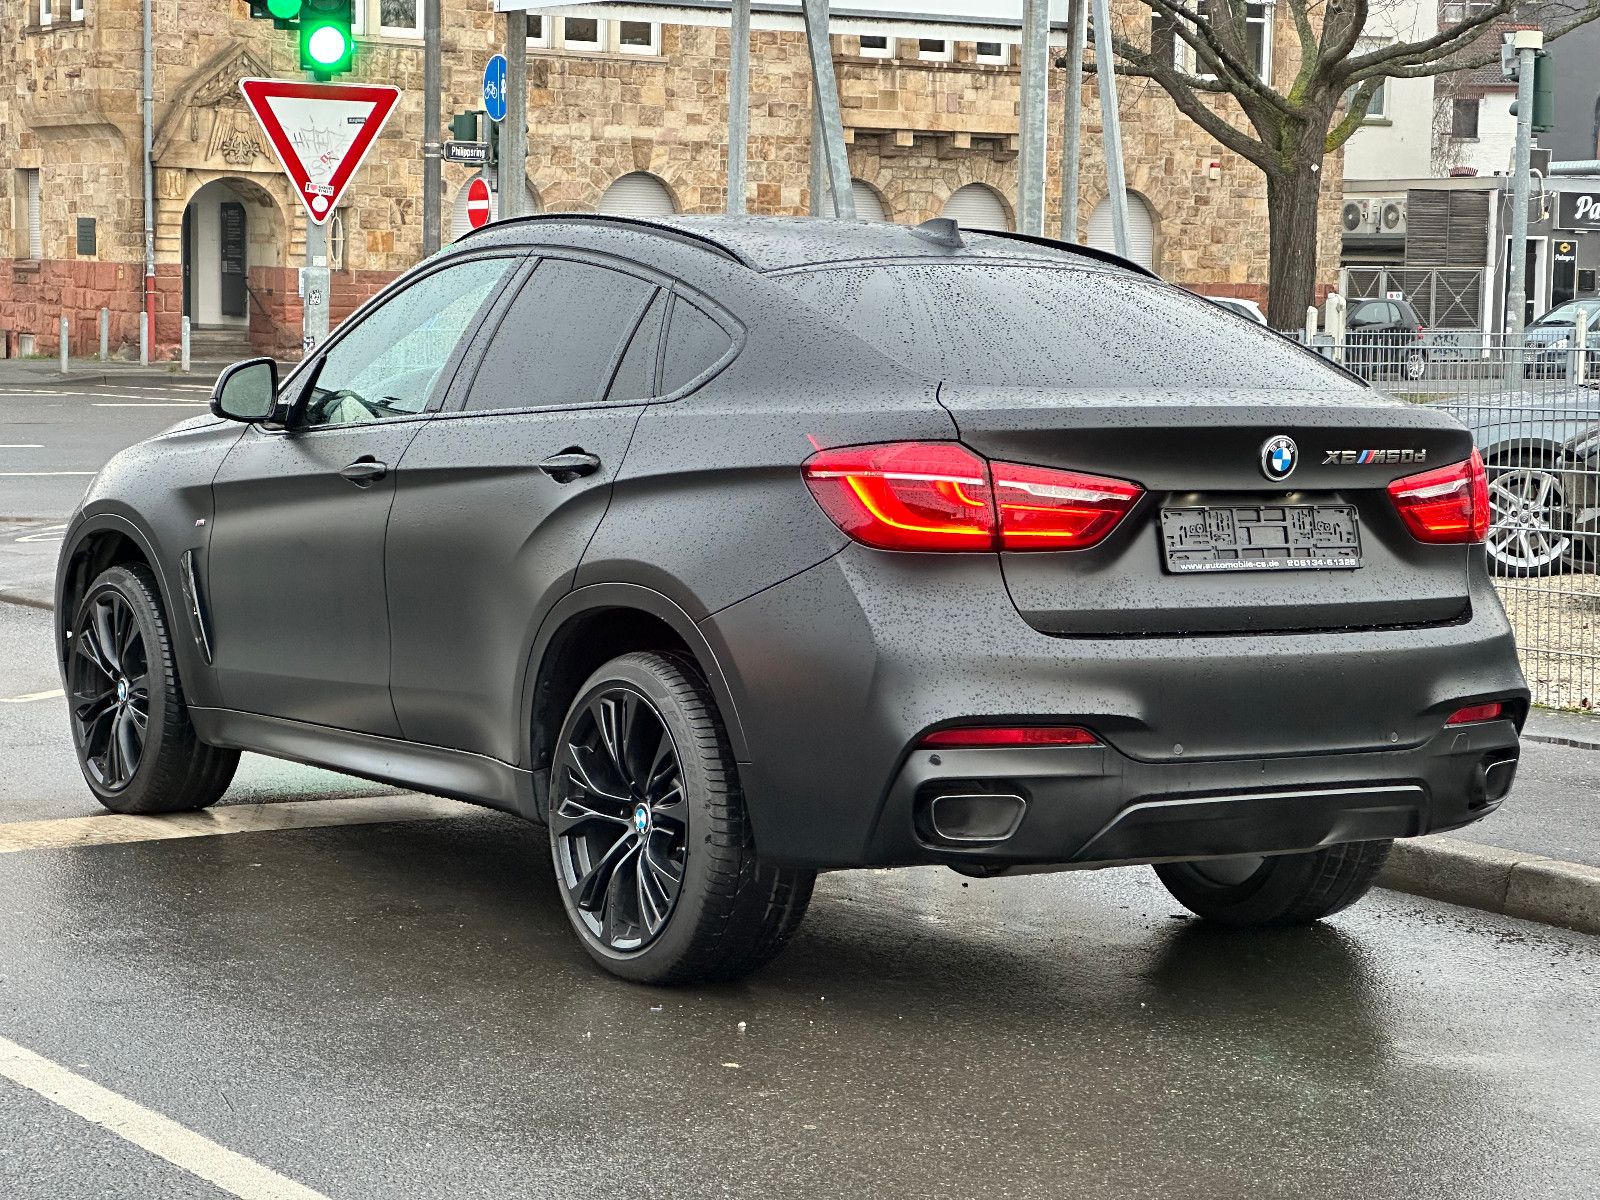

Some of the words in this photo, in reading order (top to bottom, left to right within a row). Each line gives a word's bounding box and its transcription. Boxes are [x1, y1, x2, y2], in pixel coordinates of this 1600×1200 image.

[451, 146, 485, 158] Philippsring
[1322, 450, 1357, 465] X6
[1372, 448, 1427, 465] M50d
[1180, 559, 1280, 570] www.automobile-cs.de
